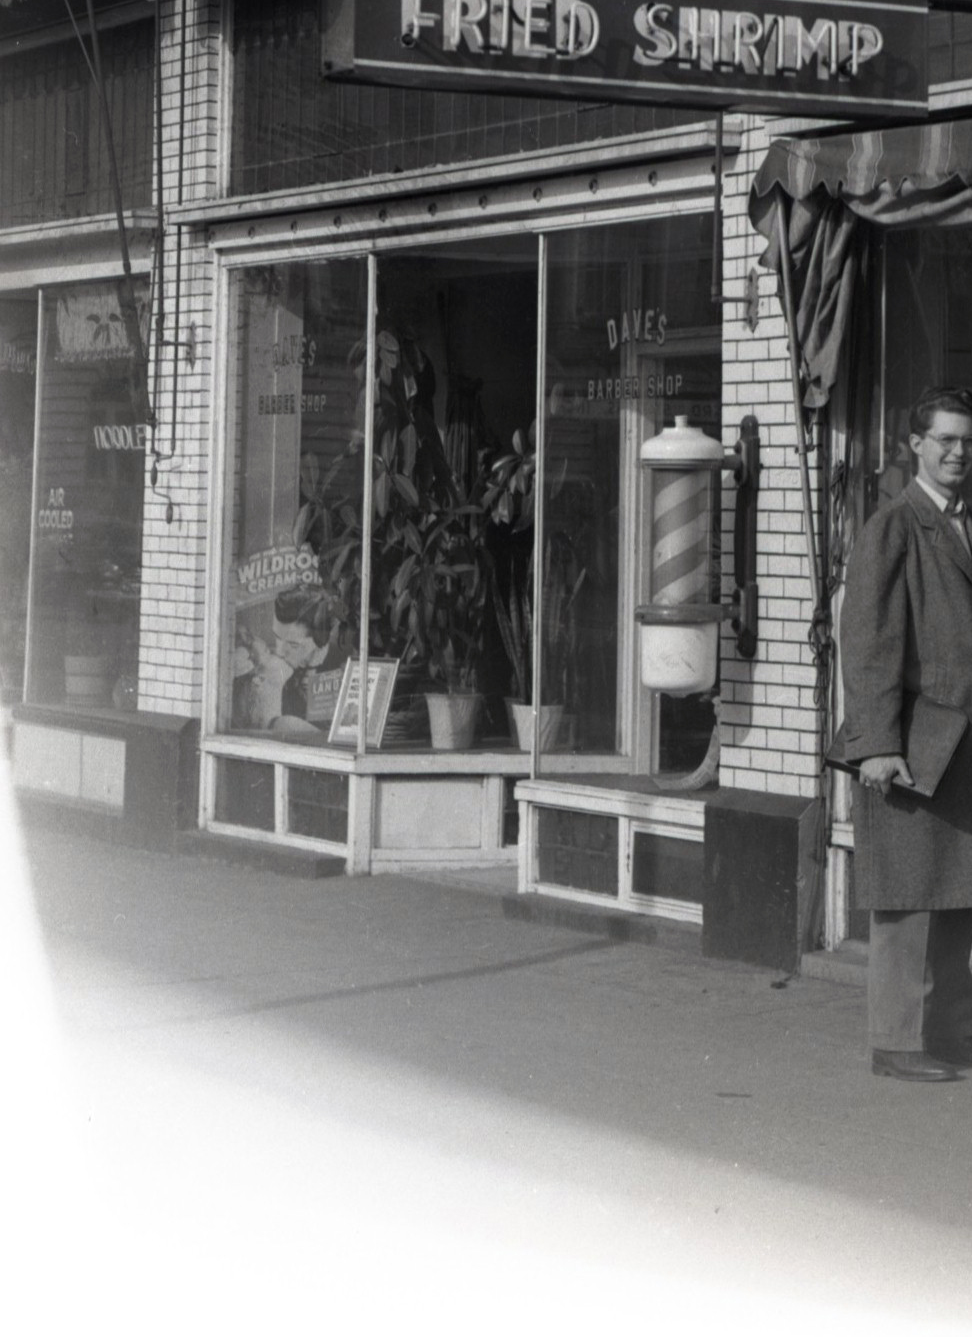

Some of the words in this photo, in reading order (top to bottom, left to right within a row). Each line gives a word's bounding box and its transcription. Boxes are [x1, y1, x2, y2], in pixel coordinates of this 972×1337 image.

[633, 1, 884, 82] SHRIMP
[607, 306, 667, 351] DAVE'S
[587, 378, 639, 401] BARBER
[647, 374, 682, 397] SHOP
[300, 393, 327, 413] SHOP
[93, 424, 145, 451] NOODLE
[47, 487, 65, 507] AIR
[38, 509, 74, 530] COOLED
